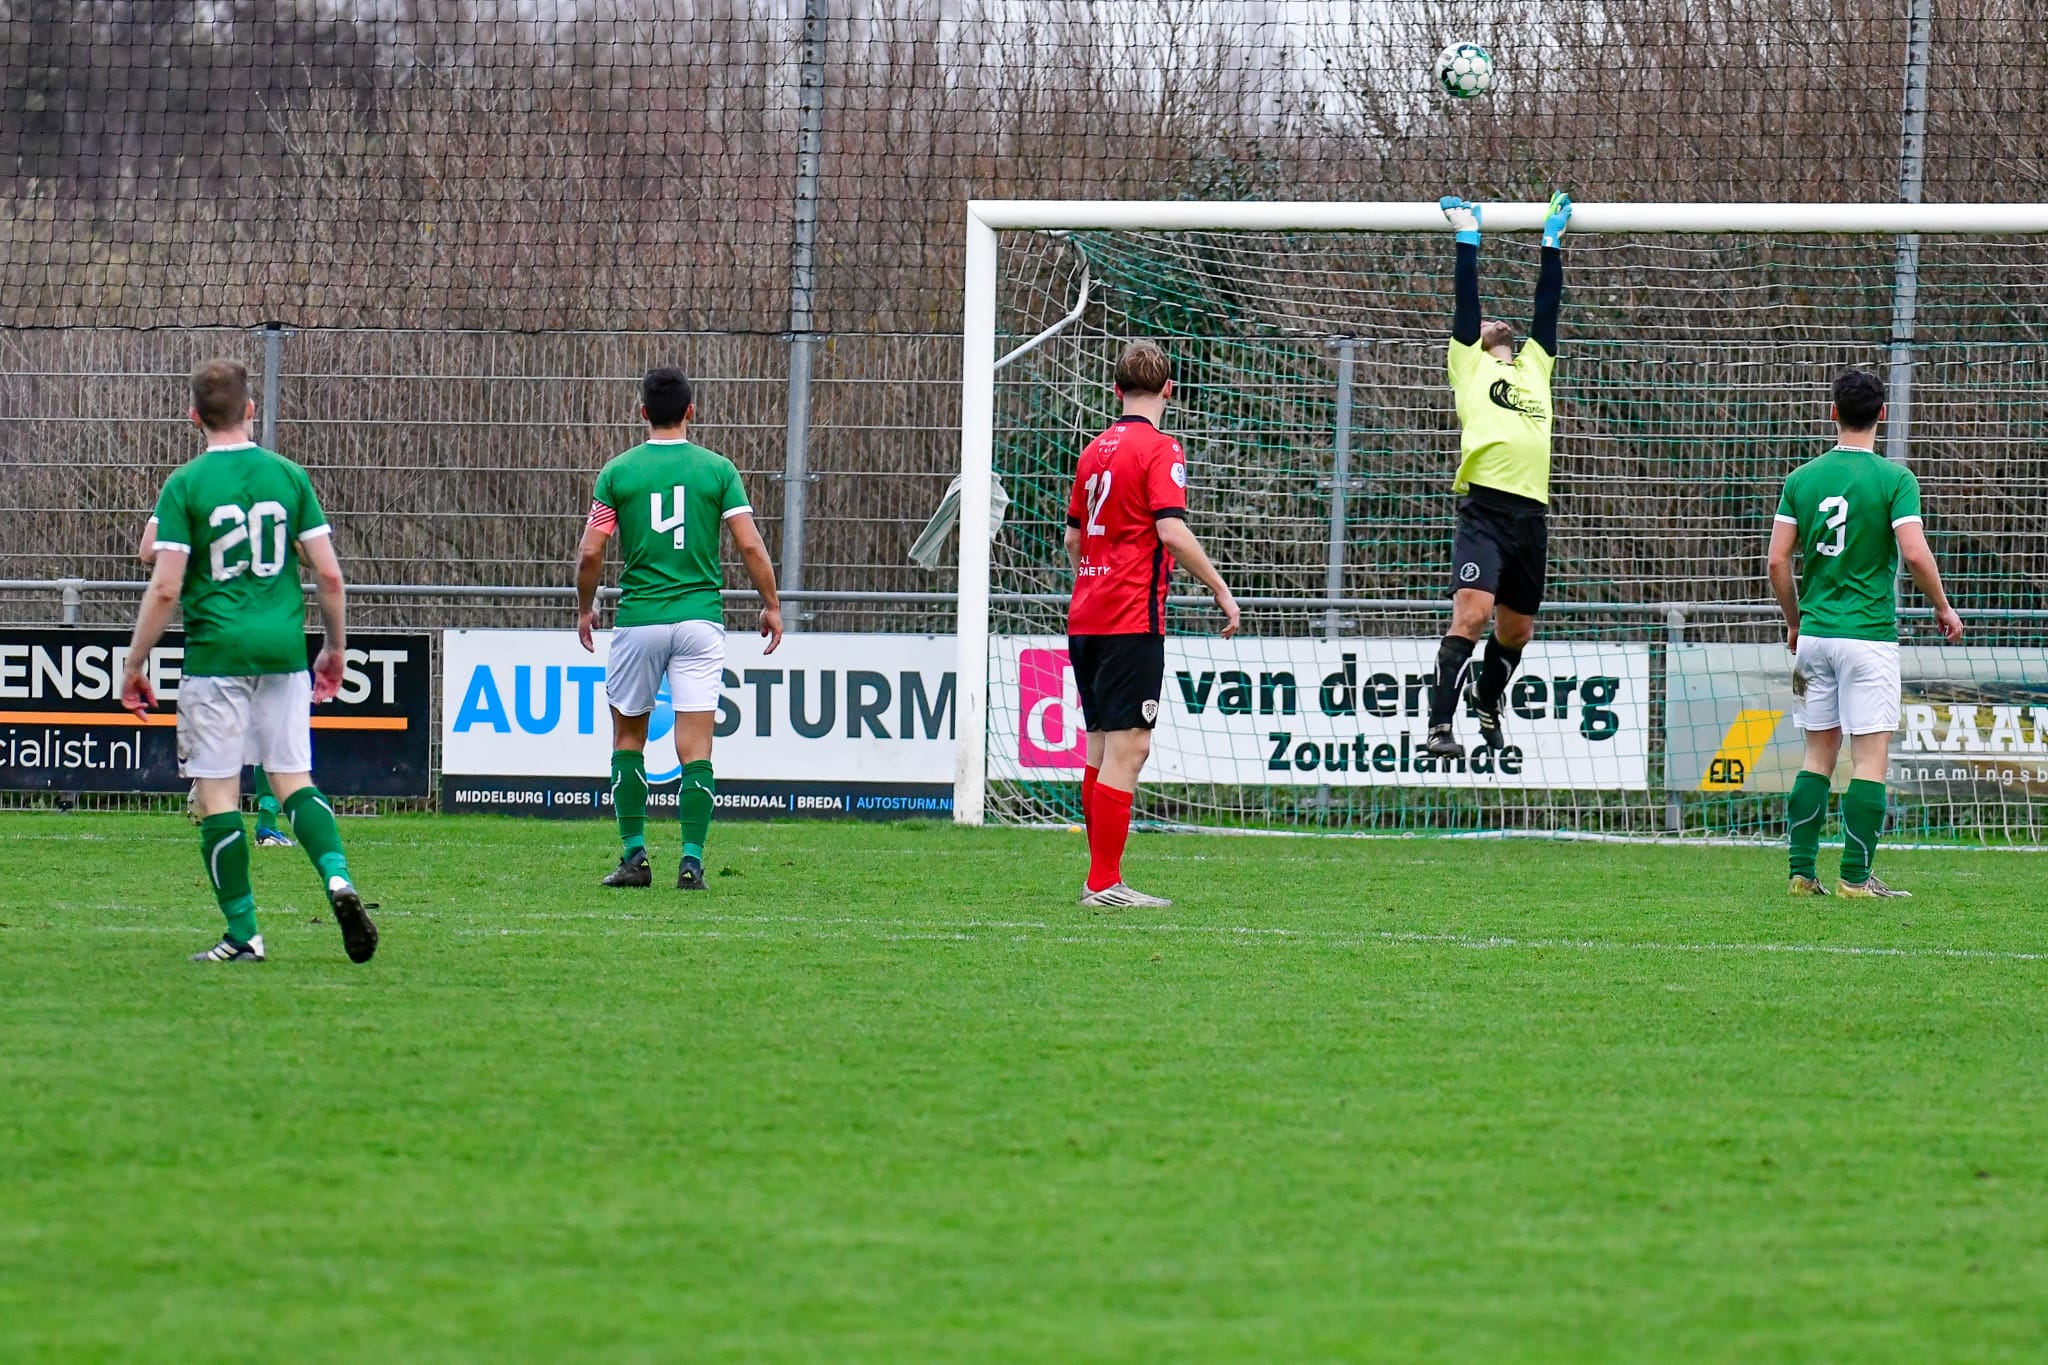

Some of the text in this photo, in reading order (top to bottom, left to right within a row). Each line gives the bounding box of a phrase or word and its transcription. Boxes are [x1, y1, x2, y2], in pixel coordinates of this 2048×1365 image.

[650, 485, 685, 550] 4
[1084, 470, 1112, 537] 12
[1816, 495, 1849, 557] 3
[208, 500, 288, 582] 20
[1175, 670, 1297, 716] van
[0, 728, 141, 770] ialist.nl
[455, 790, 544, 804] MIDDELBURG
[554, 792, 591, 805] GOES
[797, 796, 842, 809] BREDA
